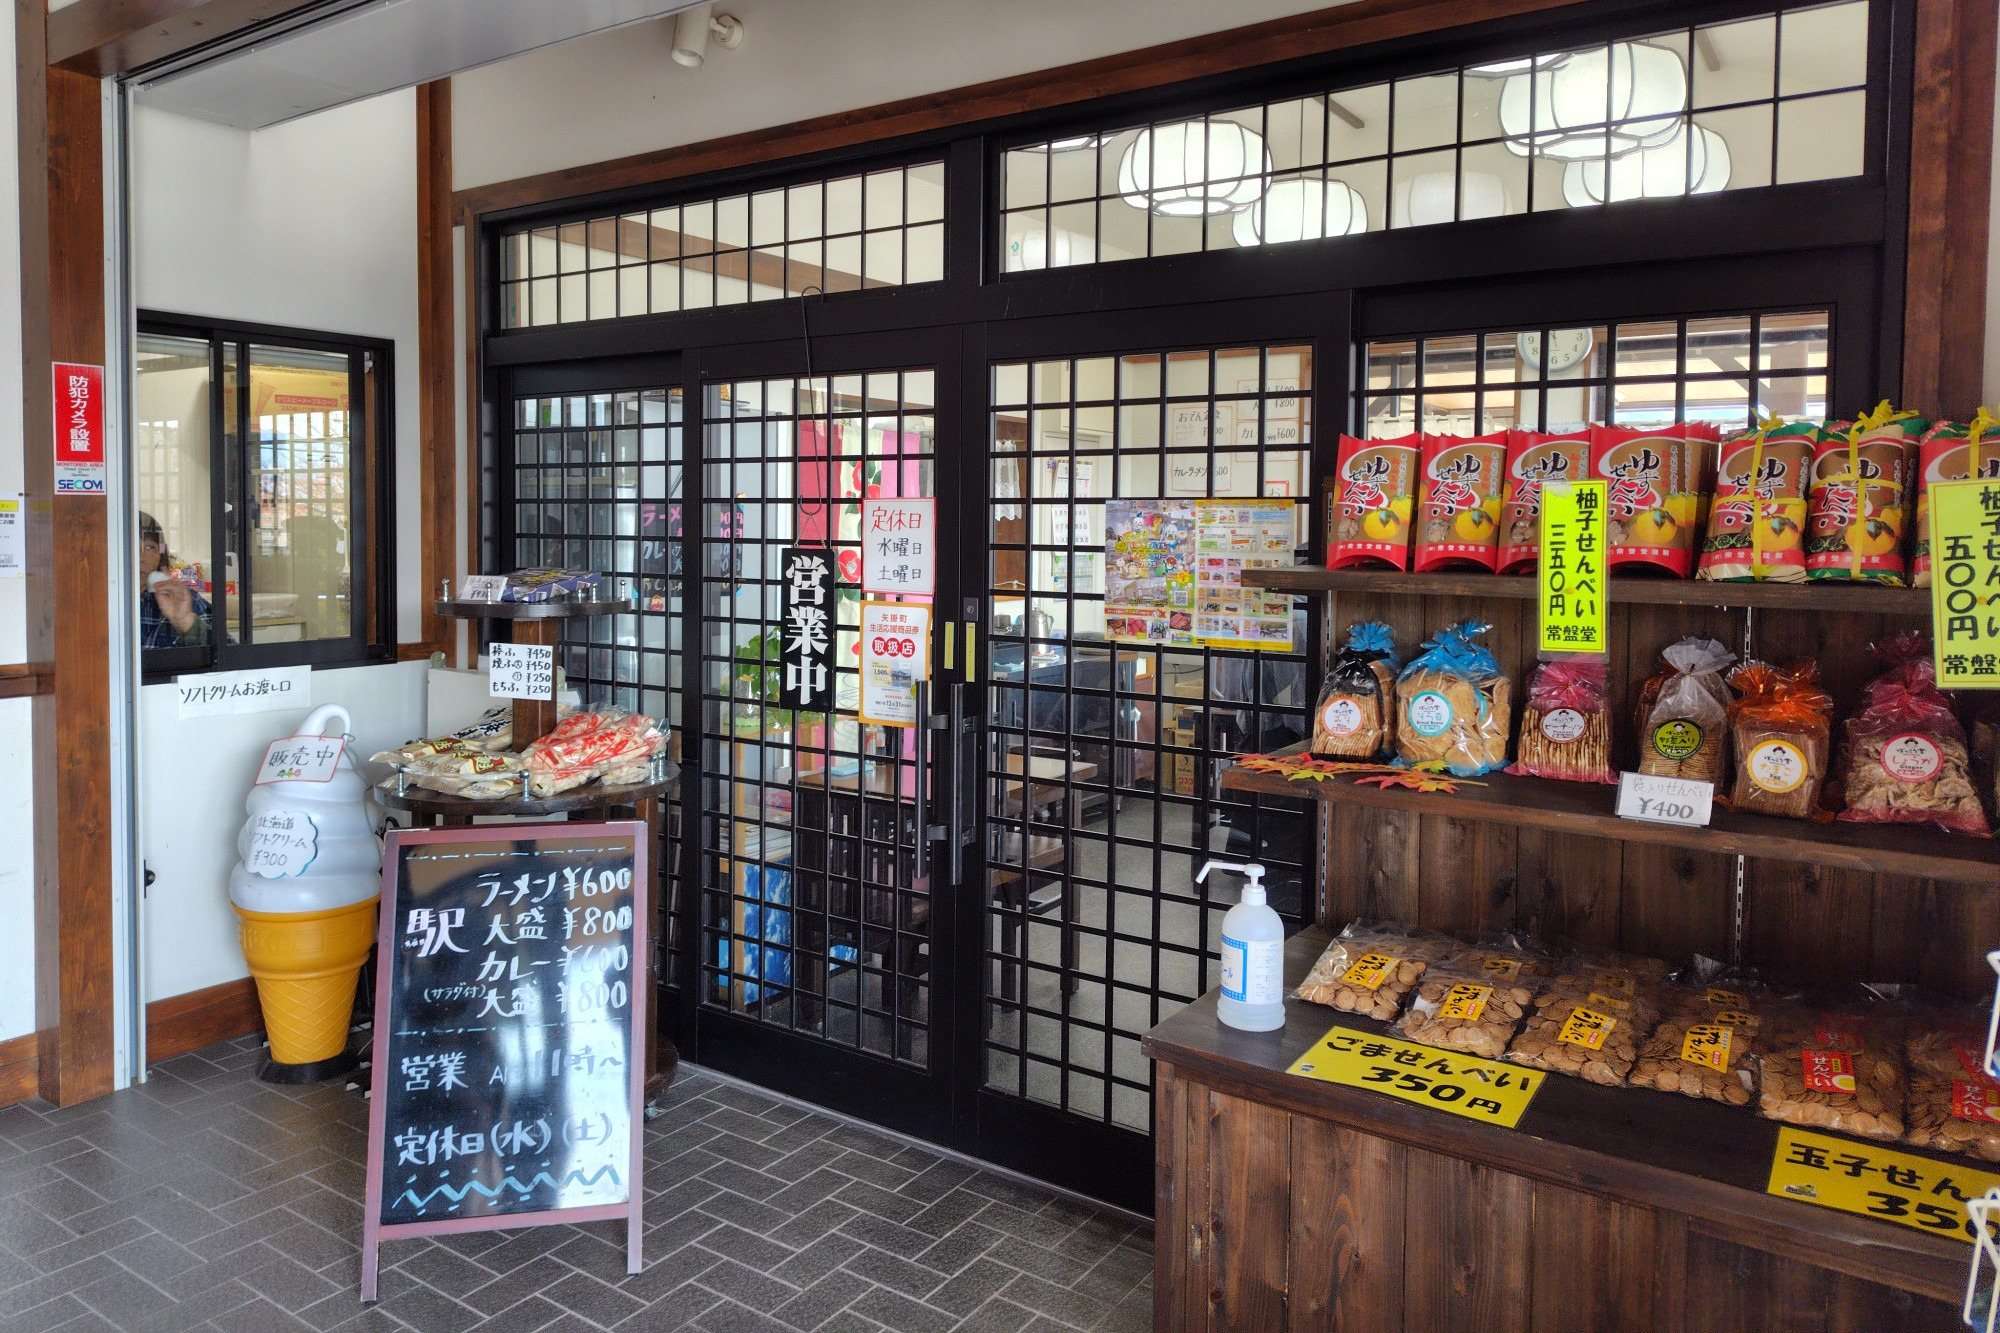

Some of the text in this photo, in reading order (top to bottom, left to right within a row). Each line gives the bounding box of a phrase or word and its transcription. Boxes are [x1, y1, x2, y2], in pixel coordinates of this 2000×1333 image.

[1528, 335, 1534, 344] 9
[1577, 332, 1583, 341] 3
[1532, 347, 1538, 355] 8
[1572, 344, 1578, 352] 4
[1551, 356, 1558, 364] 6
[69, 375, 91, 452] 防犯カメラ設置
[1277, 428, 1296, 439] ¥600
[58, 479, 103, 490] SECOM
[871, 505, 922, 533] 定休日
[877, 537, 922, 557] 水曜日
[1575, 488, 1599, 618] 柚子せんべい
[877, 564, 922, 583] 土曜日
[1549, 523, 1567, 617] 三五〇円
[1943, 535, 1980, 641] 五〇〇円
[881, 613, 908, 623] 矢掛町
[785, 555, 829, 705] 営業中
[870, 623, 920, 635] 生活応援商品券
[1546, 625, 1597, 642] 常盤堂
[526, 647, 552, 660] ¥450
[874, 639, 913, 655] 取扱店
[526, 660, 551, 671] ¥450
[1942, 653, 2000, 676] 常盤
[526, 672, 552, 684] ¥250
[180, 679, 292, 704] ソフトクリームお渡し口
[492, 681, 551, 696] もちふ ¥250
[268, 745, 335, 767] 販売中
[1892, 755, 1933, 765] しょうが
[1638, 797, 1694, 819] ¥400
[256, 815, 295, 831] 北海道
[250, 831, 308, 849] ソフトクリーム
[253, 849, 288, 866] ¥300
[476, 866, 632, 907] ラーメン ¥600
[402, 908, 470, 957] 駅
[482, 905, 633, 946] 大盛 ¥800
[475, 944, 629, 982] カレー ¥600
[476, 979, 541, 1019] 大盛
[555, 980, 628, 1014] ¥800
[401, 1050, 469, 1092] 営業
[1326, 1035, 1530, 1091] ごませんべい
[1361, 1066, 1503, 1115] 350円
